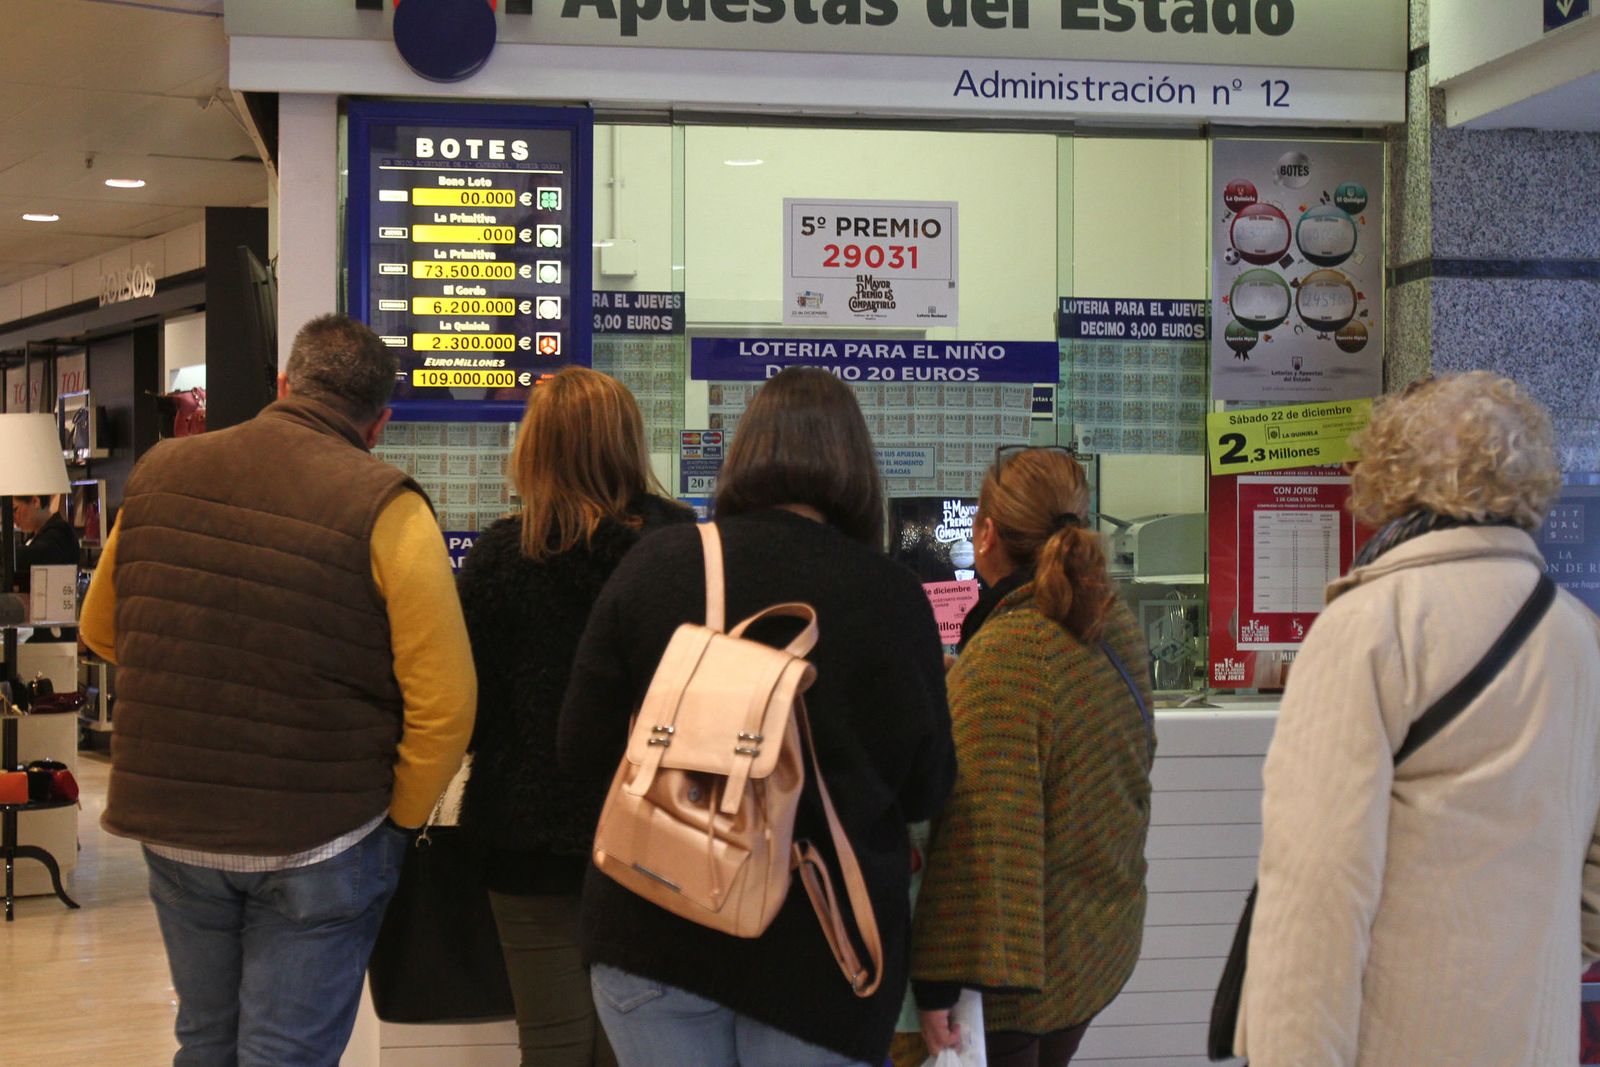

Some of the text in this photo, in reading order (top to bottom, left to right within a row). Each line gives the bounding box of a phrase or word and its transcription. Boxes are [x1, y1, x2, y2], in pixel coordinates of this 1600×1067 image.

[953, 69, 1195, 105] Administración
[1260, 79, 1290, 107] 12
[415, 137, 529, 160] BOTES
[1280, 165, 1310, 177] BOTES
[460, 191, 532, 206] 00.000 €
[434, 213, 496, 224] La Primitiva
[800, 216, 942, 239] 5º PREMIO
[476, 229, 532, 243] .000 €
[434, 249, 496, 260] La Primitiva
[822, 244, 918, 269] 29031
[424, 265, 532, 279] 73.500.000 €
[856, 274, 891, 291] EL MAYOR
[455, 286, 486, 296] Gordo
[856, 283, 883, 300] PREMIO
[433, 301, 532, 315] 6.200.000 €
[614, 293, 630, 308] EL
[634, 294, 681, 309] JUEVES
[849, 296, 896, 313] COMPARTIRLO
[1062, 301, 1110, 315] LOTERIA
[1114, 301, 1145, 315] PARA
[1150, 303, 1165, 316] EL
[439, 321, 452, 331] La
[593, 314, 673, 332] 3,00 EUROS
[1080, 321, 1206, 339] DECIMO 3,00 EUROS
[432, 336, 531, 350] 2.300.000 €
[739, 341, 1006, 360] LOTERIA PARA EL NIÑO
[420, 372, 531, 386] 109.000.000 €
[867, 366, 896, 381] 20
[901, 366, 980, 382] EUROS
[1229, 405, 1353, 425] Sábado 22 de diciembre
[1268, 446, 1321, 461] Millones
[690, 478, 704, 488] 20
[1273, 486, 1319, 495] CON JOKER
[943, 501, 952, 510] EL
[943, 510, 973, 529] PREMIO
[1566, 563, 1584, 573] DE
[933, 586, 971, 595] diciembre
